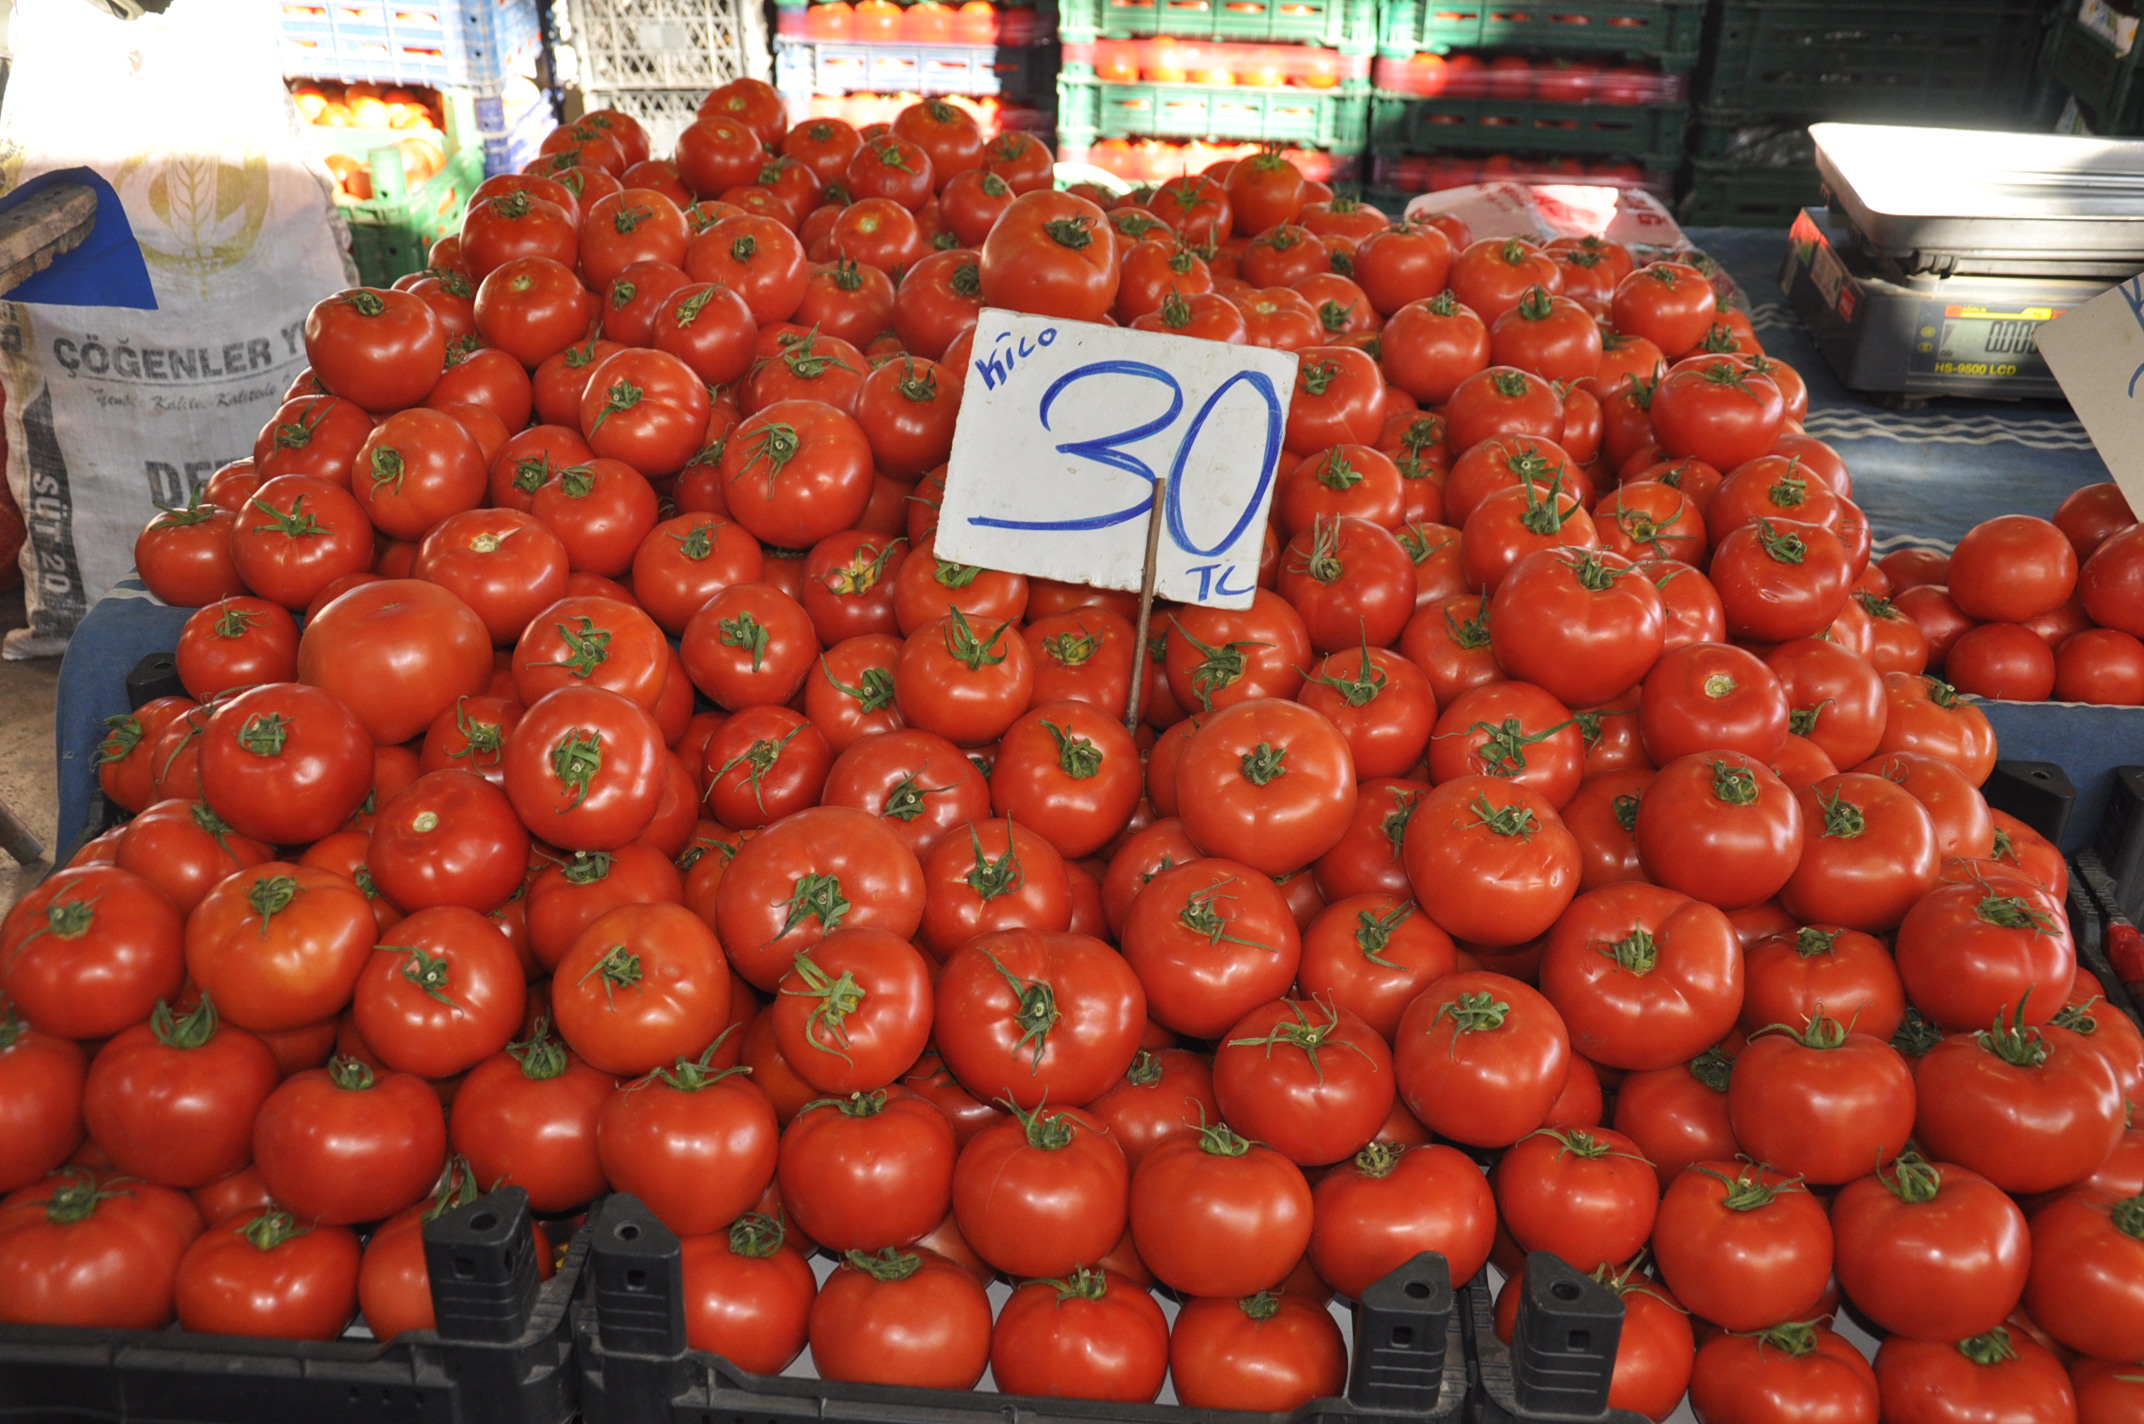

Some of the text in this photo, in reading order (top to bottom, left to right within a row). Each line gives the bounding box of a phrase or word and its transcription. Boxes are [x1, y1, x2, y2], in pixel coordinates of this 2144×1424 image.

[53, 333, 272, 380] ÇÖĞENLER
[1989, 363, 2017, 376] LCD
[145, 457, 243, 507] DE
[967, 360, 1283, 557] 30
[32, 472, 68, 543] SÜT
[41, 551, 70, 594] 20
